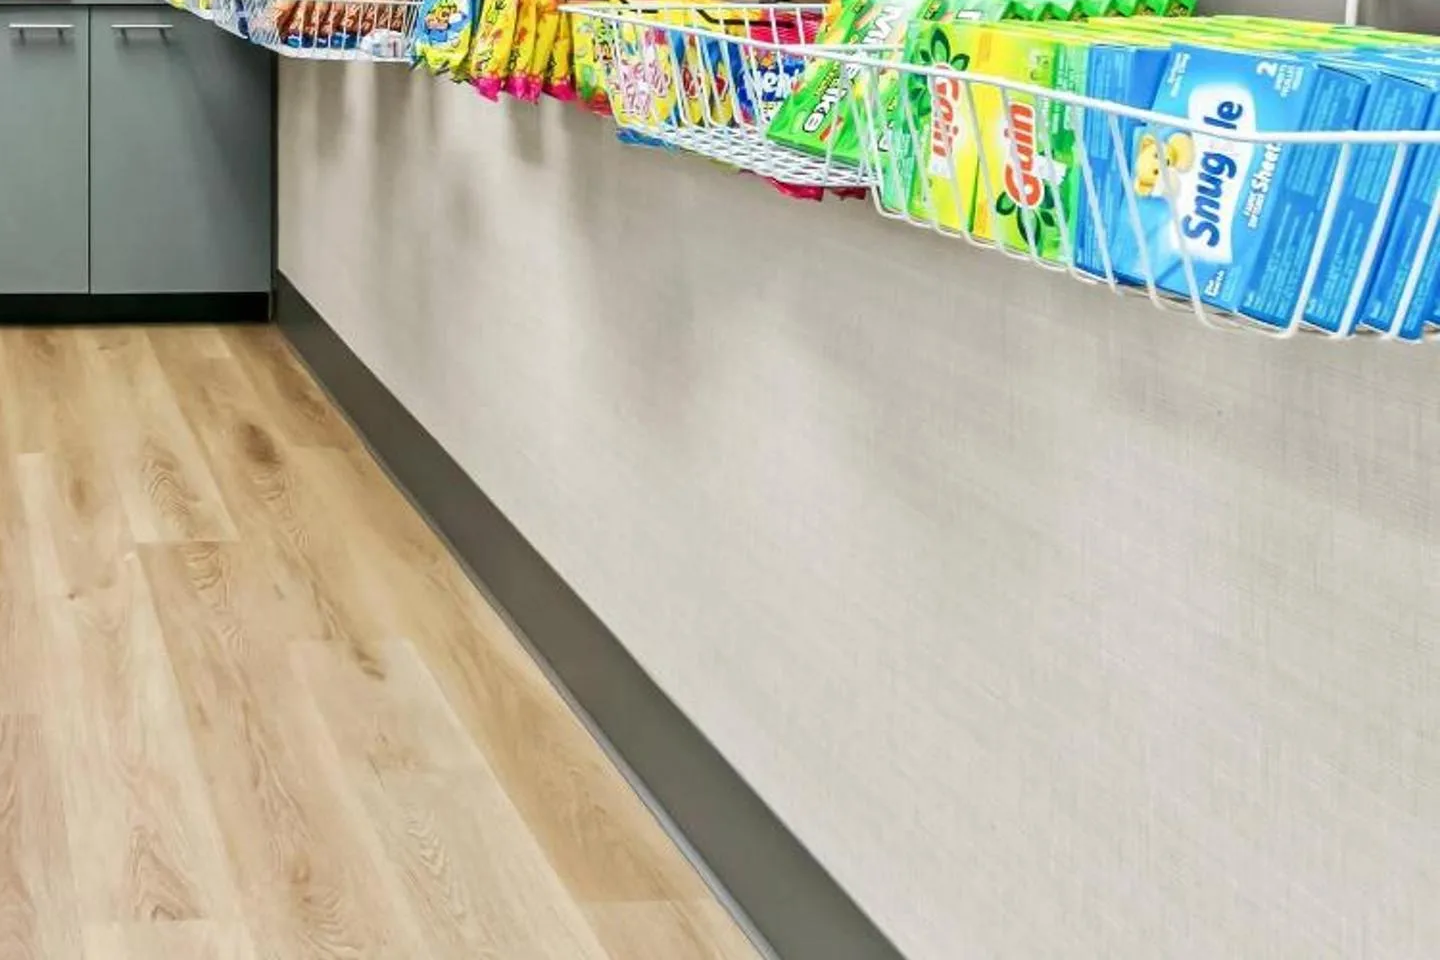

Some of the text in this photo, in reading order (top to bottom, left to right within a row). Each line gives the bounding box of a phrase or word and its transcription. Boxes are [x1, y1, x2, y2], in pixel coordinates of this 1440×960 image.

[1003, 103, 1043, 208] Gain
[1181, 99, 1244, 249] Snugle
[1249, 138, 1282, 193] Sheet
